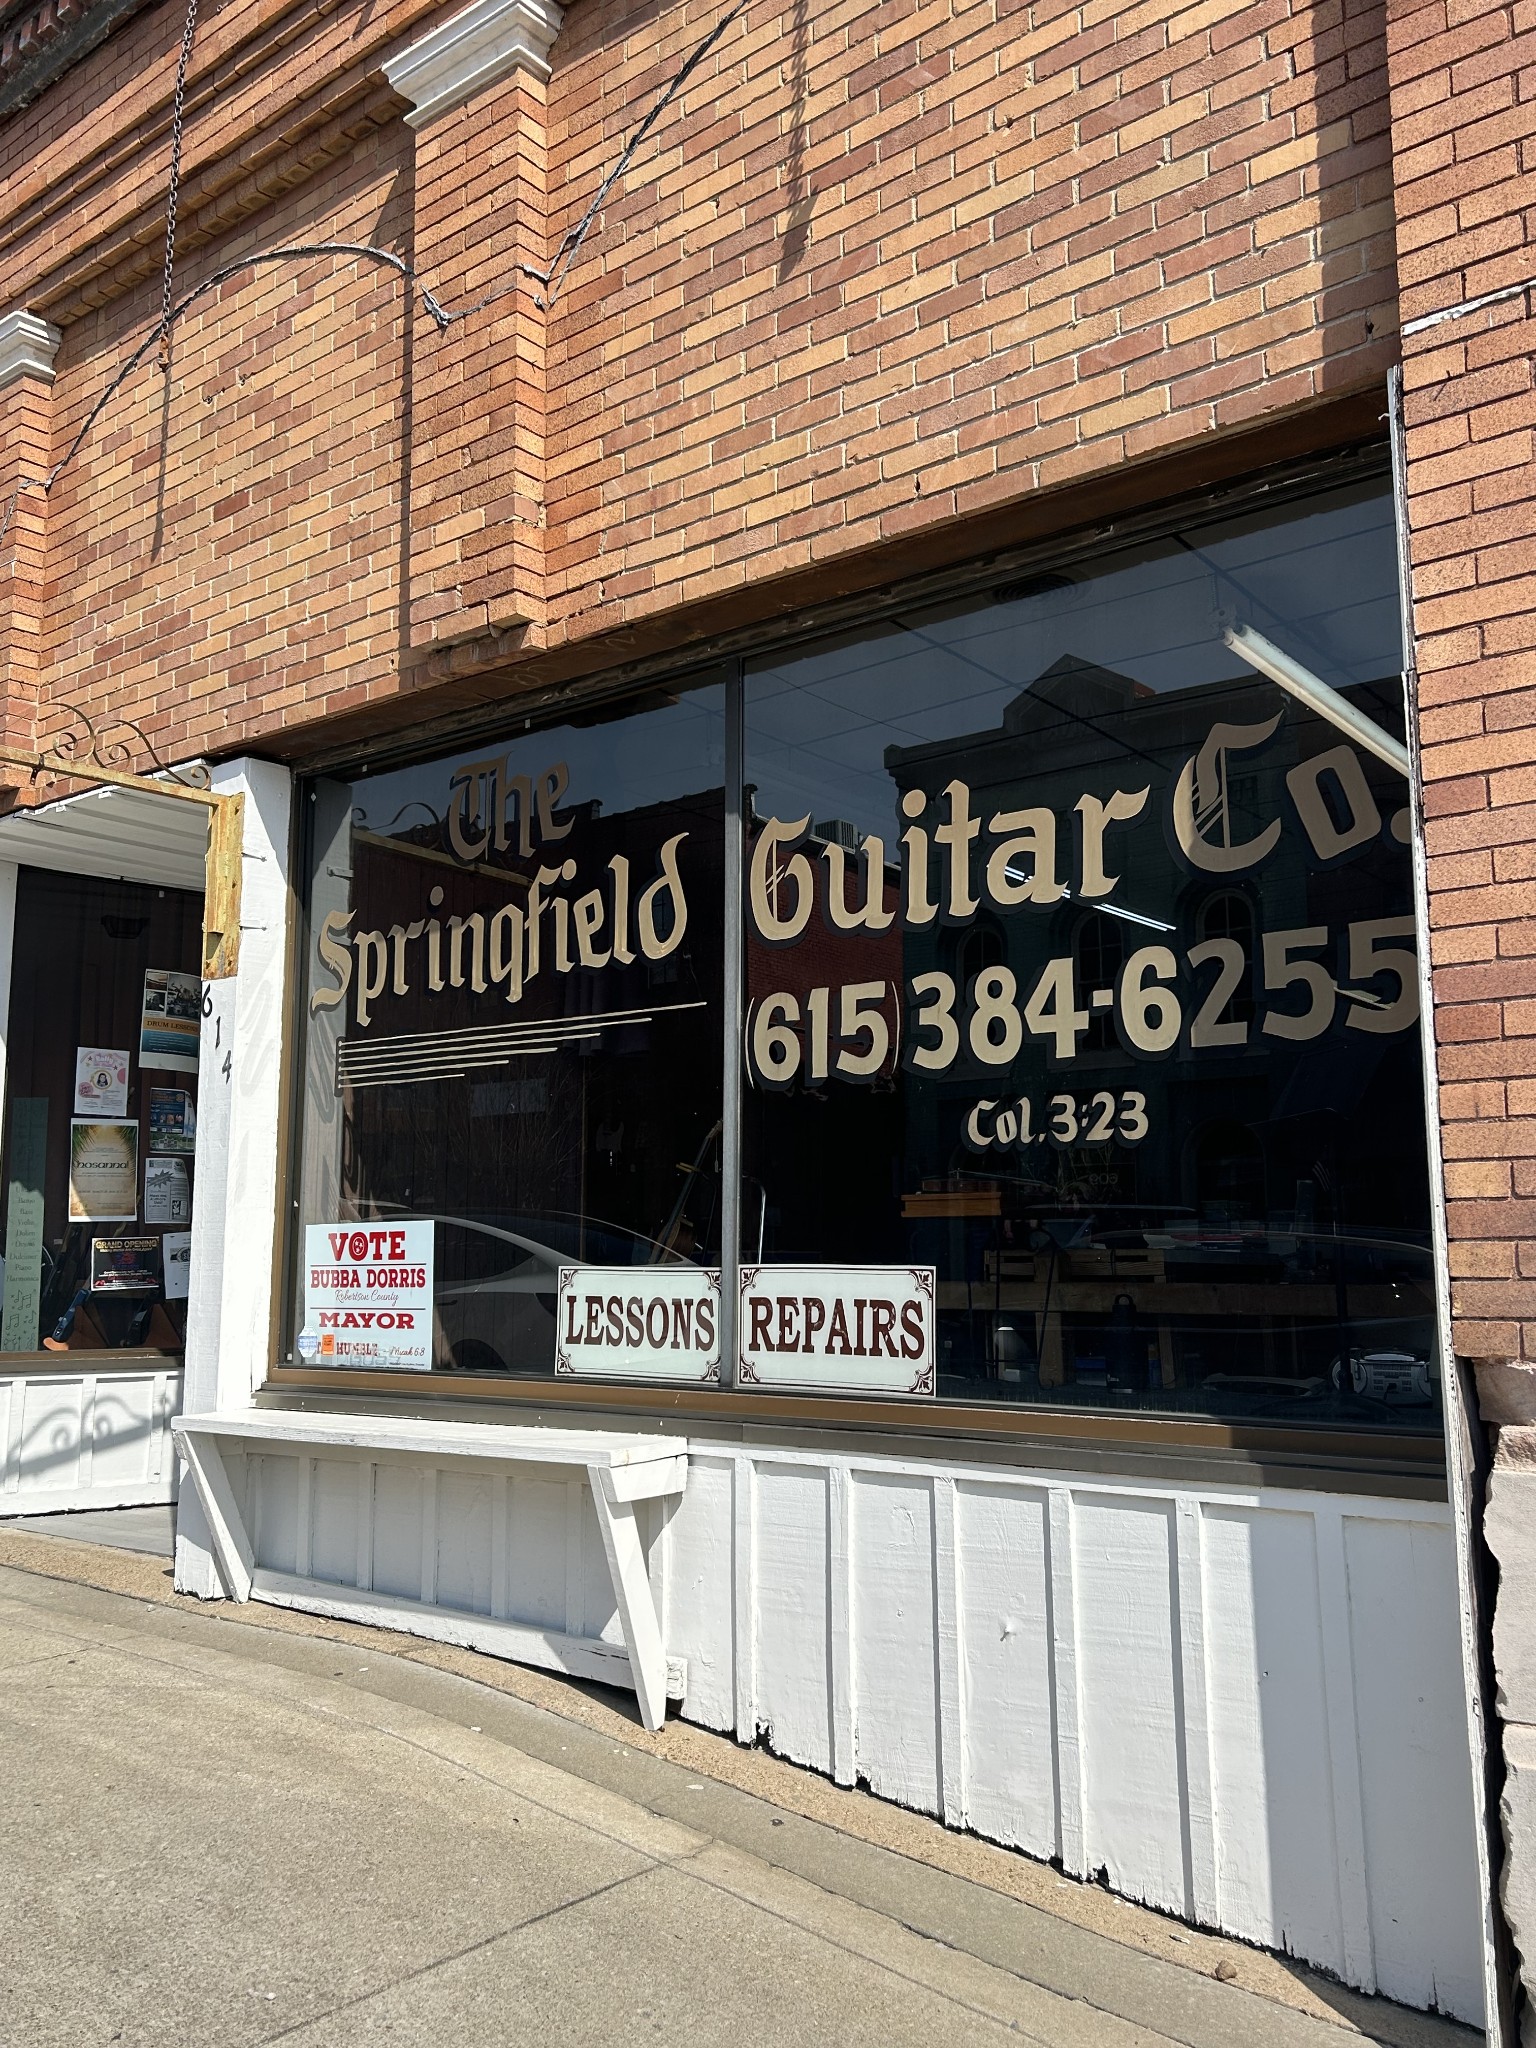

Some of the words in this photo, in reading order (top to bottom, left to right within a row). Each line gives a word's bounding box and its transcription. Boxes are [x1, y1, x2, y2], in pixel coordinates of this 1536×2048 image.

[449, 751, 576, 863] The
[311, 832, 690, 1027] Springfield
[750, 779, 1151, 942] Guitar
[1173, 709, 1413, 873] Co.
[745, 981, 901, 1090] (615)
[911, 915, 1420, 1072] 384-6255
[146, 1020, 169, 1029] DRUM
[170, 1022, 198, 1033] LESSONS
[95, 1240, 123, 1249] GRAND
[328, 1230, 406, 1262] VOTE
[310, 1269, 362, 1289] BUBBA
[366, 1268, 426, 1289] DORRIS
[334, 1289, 370, 1304] Robertson
[371, 1289, 400, 1306] County
[318, 1312, 415, 1330] MAYOR
[565, 1294, 715, 1352] LESSONS
[747, 1296, 925, 1361] REPAIRS
